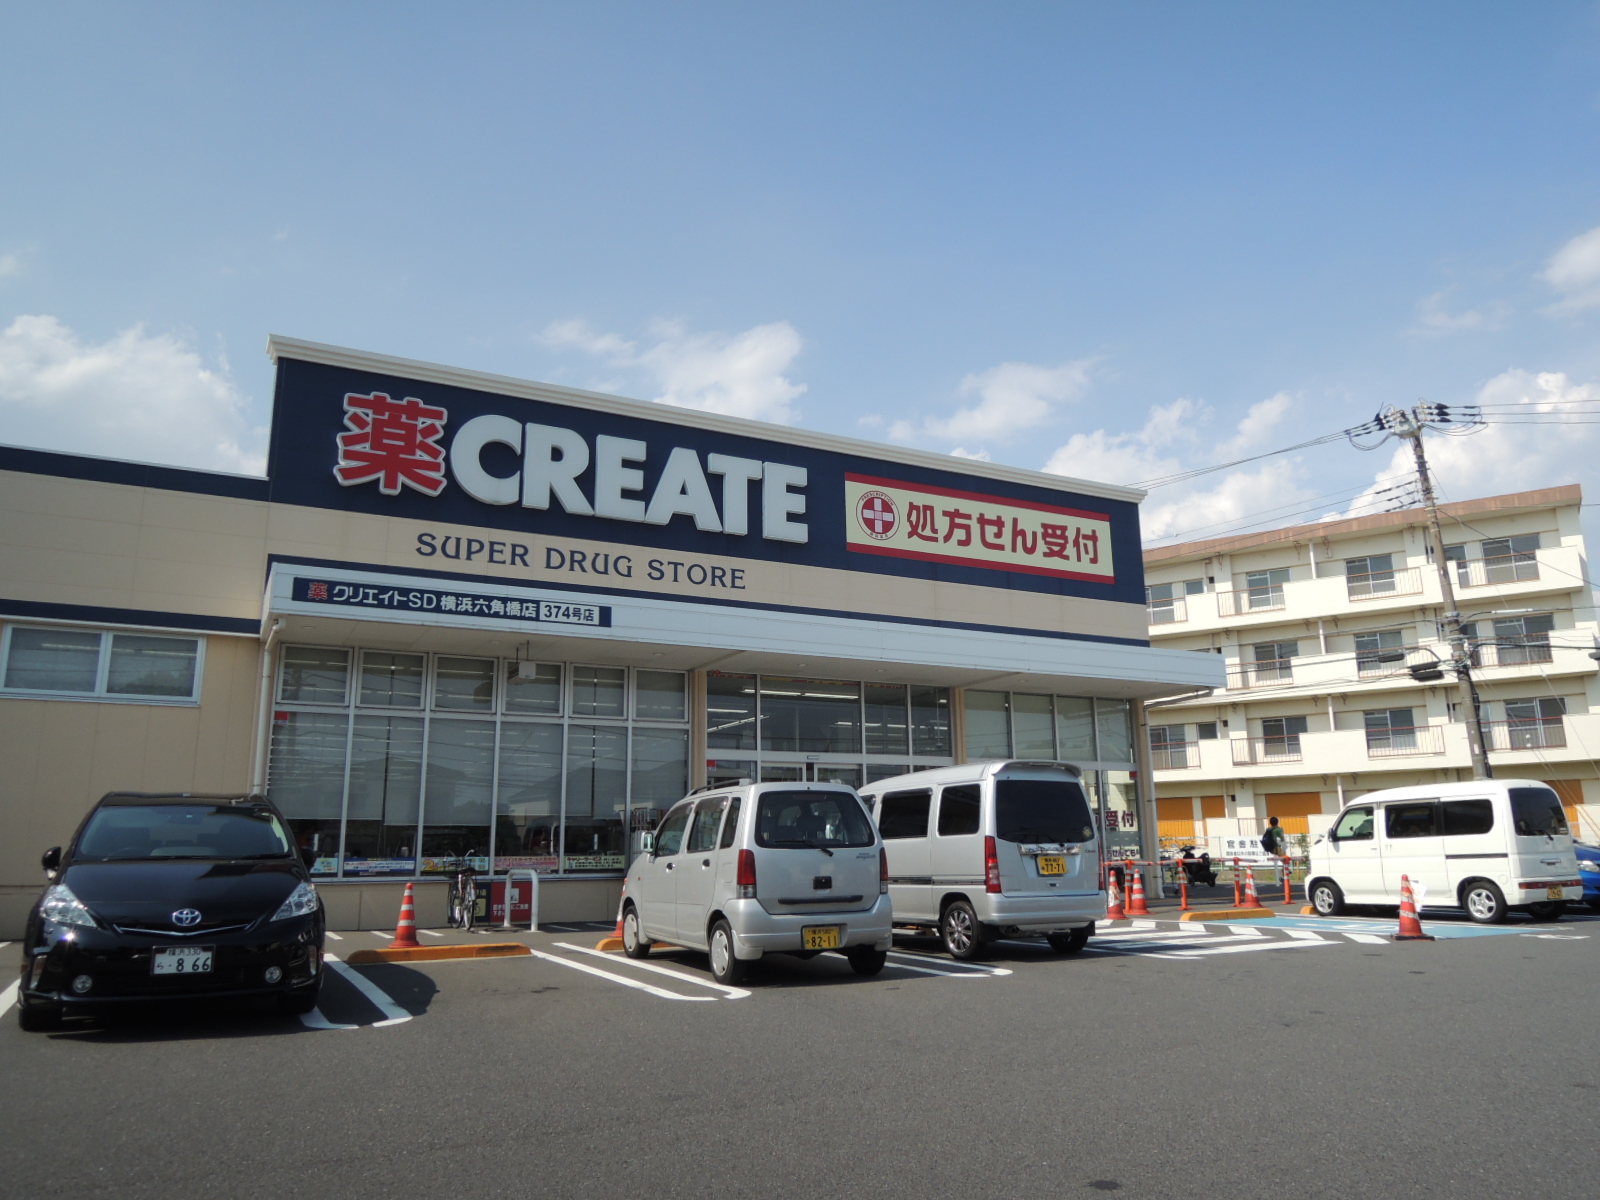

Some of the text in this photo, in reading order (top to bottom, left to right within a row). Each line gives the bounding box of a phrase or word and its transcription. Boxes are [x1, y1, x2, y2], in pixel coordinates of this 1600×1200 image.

[333, 391, 809, 543] 薬 CREATE
[860, 491, 896, 507] PRESCRIPTION
[906, 501, 1099, 565] 処方せん受付
[415, 532, 747, 590] SUPER DRUG STORE
[308, 582, 596, 624] 薬 クリエイトSD 横浜六角橋店 374号店
[811, 935, 837, 948] 82-11
